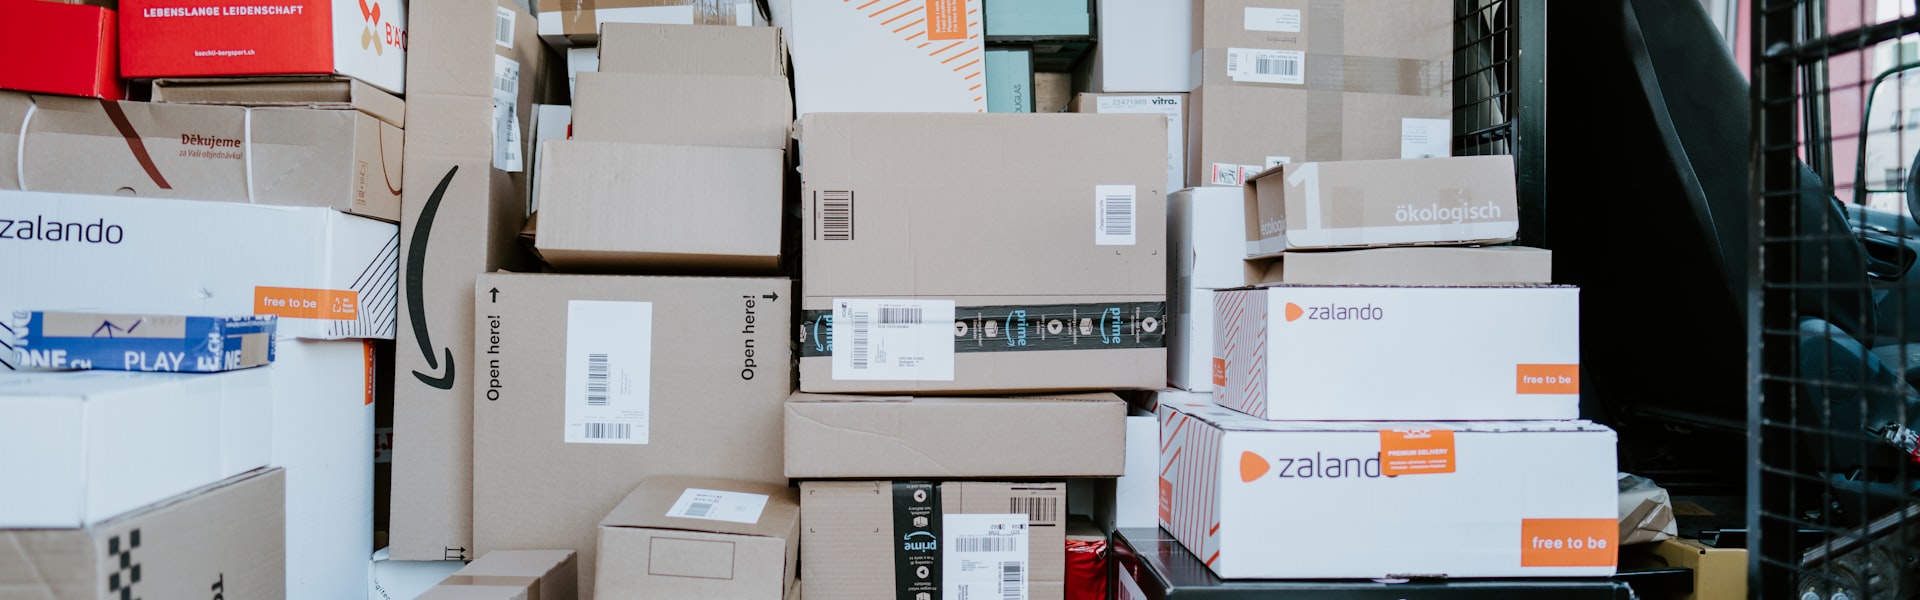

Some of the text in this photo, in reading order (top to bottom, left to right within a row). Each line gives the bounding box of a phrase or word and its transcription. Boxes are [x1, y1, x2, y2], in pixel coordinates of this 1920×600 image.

[143, 5, 304, 18] LEBENSLANGE LEIDENSCHAFT
[194, 49, 255, 57] baechli-bergsport.ch
[1151, 96, 1178, 105] vitra.
[181, 133, 242, 149] Děkujeme
[1395, 200, 1502, 224] ökologisch
[0, 214, 124, 244] zalando
[263, 296, 317, 309] free to be
[1307, 303, 1384, 321] zalando
[823, 314, 833, 351] prime
[1014, 309, 1029, 346] prime
[1108, 307, 1122, 344] prime
[741, 294, 757, 381] Open here!
[14, 347, 93, 370] ONECH
[124, 350, 186, 372] PLAY
[486, 314, 503, 402] Open here!
[1522, 375, 1572, 385] free to be
[1387, 448, 1448, 457] PREMIUM DELIVERY
[1279, 451, 1399, 479] zaland
[904, 539, 937, 553] prime
[1531, 535, 1607, 550] free to be
